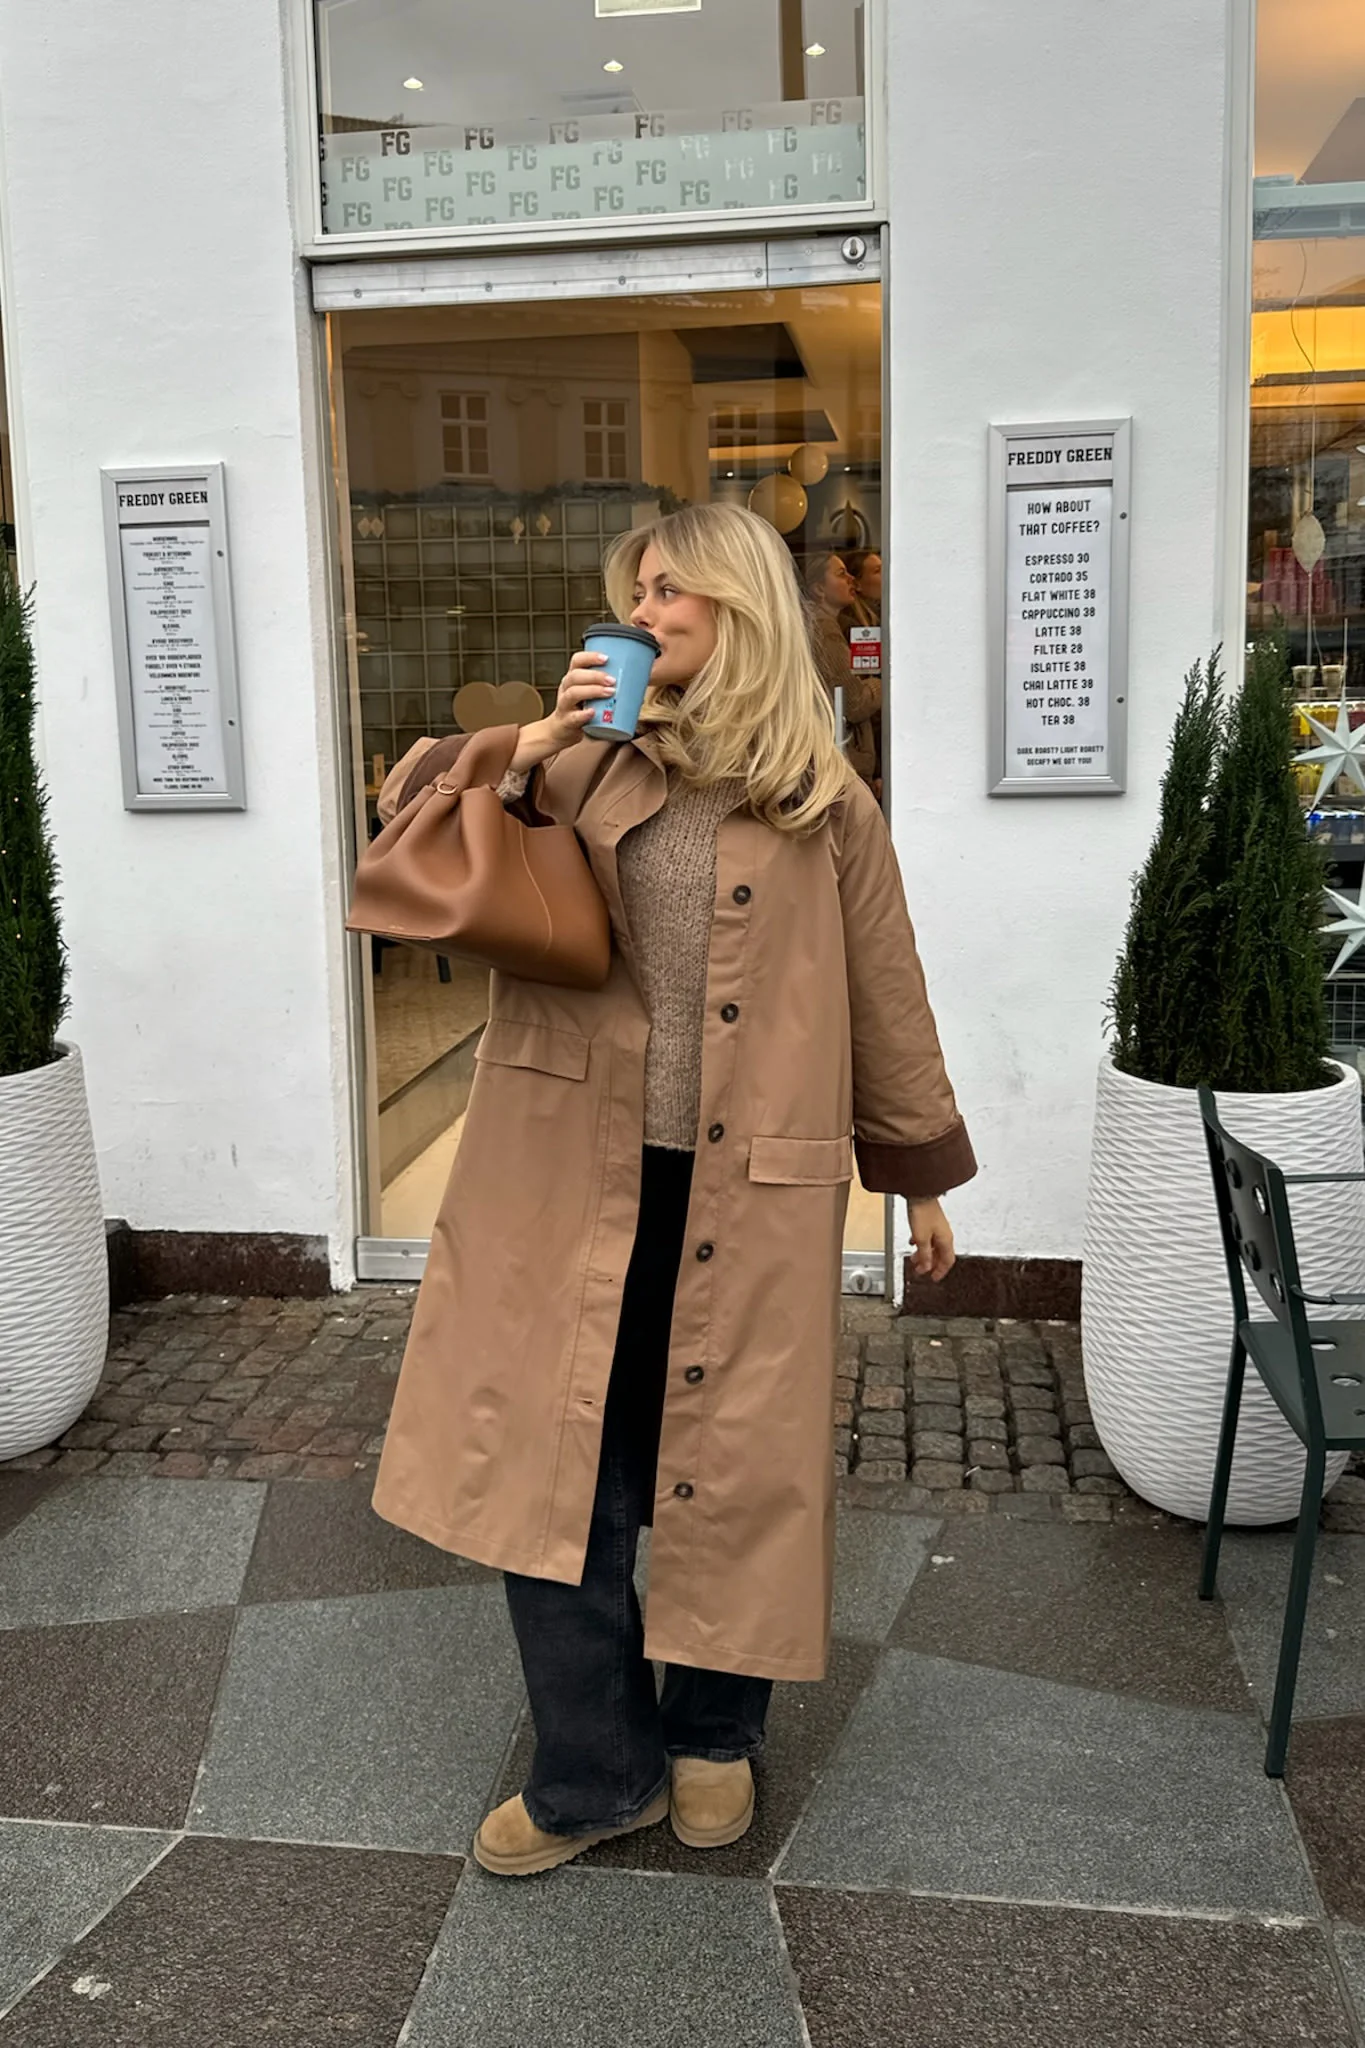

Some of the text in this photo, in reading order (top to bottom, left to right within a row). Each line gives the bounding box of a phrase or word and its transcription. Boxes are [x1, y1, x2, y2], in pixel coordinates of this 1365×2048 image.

[811, 100, 841, 126] FG
[549, 121, 579, 144] FG
[634, 113, 665, 138] FG
[381, 131, 410, 156] FG
[464, 127, 494, 151] FG
[341, 156, 370, 183] FG
[423, 150, 453, 177] FG
[507, 144, 537, 171] FG
[466, 170, 496, 197] FG
[551, 164, 581, 192] FG
[636, 159, 667, 186] FG
[383, 176, 412, 202] FG
[593, 185, 624, 212] FG
[680, 180, 710, 206] FG
[342, 201, 372, 227] FG
[425, 196, 454, 222] FG
[509, 191, 539, 217] FG
[1007, 447, 1113, 466] FREDDY GREEN
[119, 490, 208, 508] FREDDY GREEN
[1027, 499, 1091, 515] HOW ABOUT
[1019, 520, 1100, 536] THAT COFFEE?
[1025, 552, 1090, 566] ESPRESSO 30
[1029, 570, 1089, 584] CORTADO 35
[1022, 588, 1096, 602] FLAT WHITE 38
[1022, 606, 1096, 620] CAPPUCCINO 38
[1035, 625, 1082, 637] LATTE 38
[1033, 643, 1083, 655] FILTER 28
[1030, 660, 1086, 673] ISLATTE 38
[1023, 678, 1093, 691] CHAI LATTE 38
[1026, 696, 1090, 709] HOT CHOC. 38
[1041, 714, 1075, 726] TEA 38
